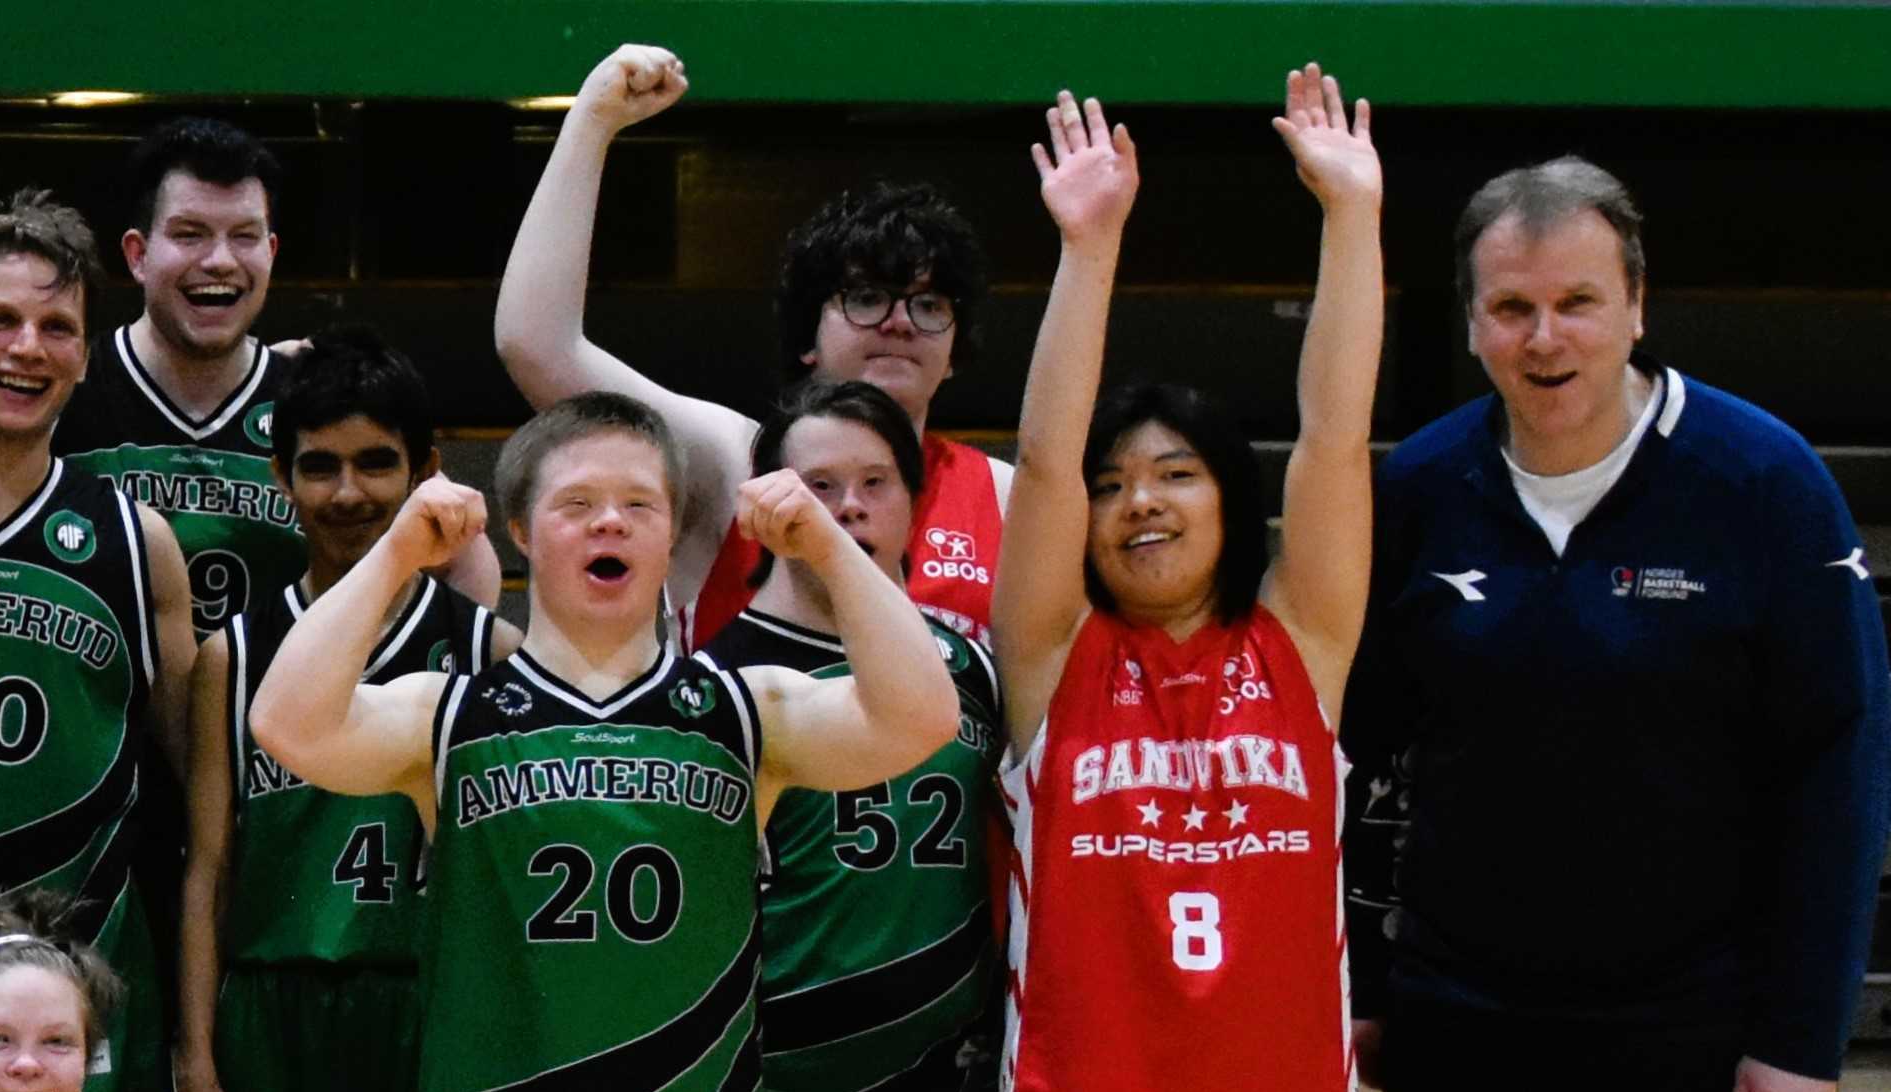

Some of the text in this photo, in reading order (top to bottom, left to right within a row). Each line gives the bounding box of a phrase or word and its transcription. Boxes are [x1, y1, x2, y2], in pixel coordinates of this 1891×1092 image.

[98, 470, 306, 527] MMERU
[57, 524, 85, 550] AIF
[922, 560, 989, 585] OBOS
[1219, 680, 1272, 715] OOS
[570, 732, 636, 744] SoulSport
[457, 756, 751, 828] AMMERUD
[832, 772, 967, 871] 52
[1071, 830, 1310, 864] SUPERSTARS
[332, 822, 397, 904] 4
[526, 843, 683, 943] 20
[1168, 891, 1223, 971] 8
